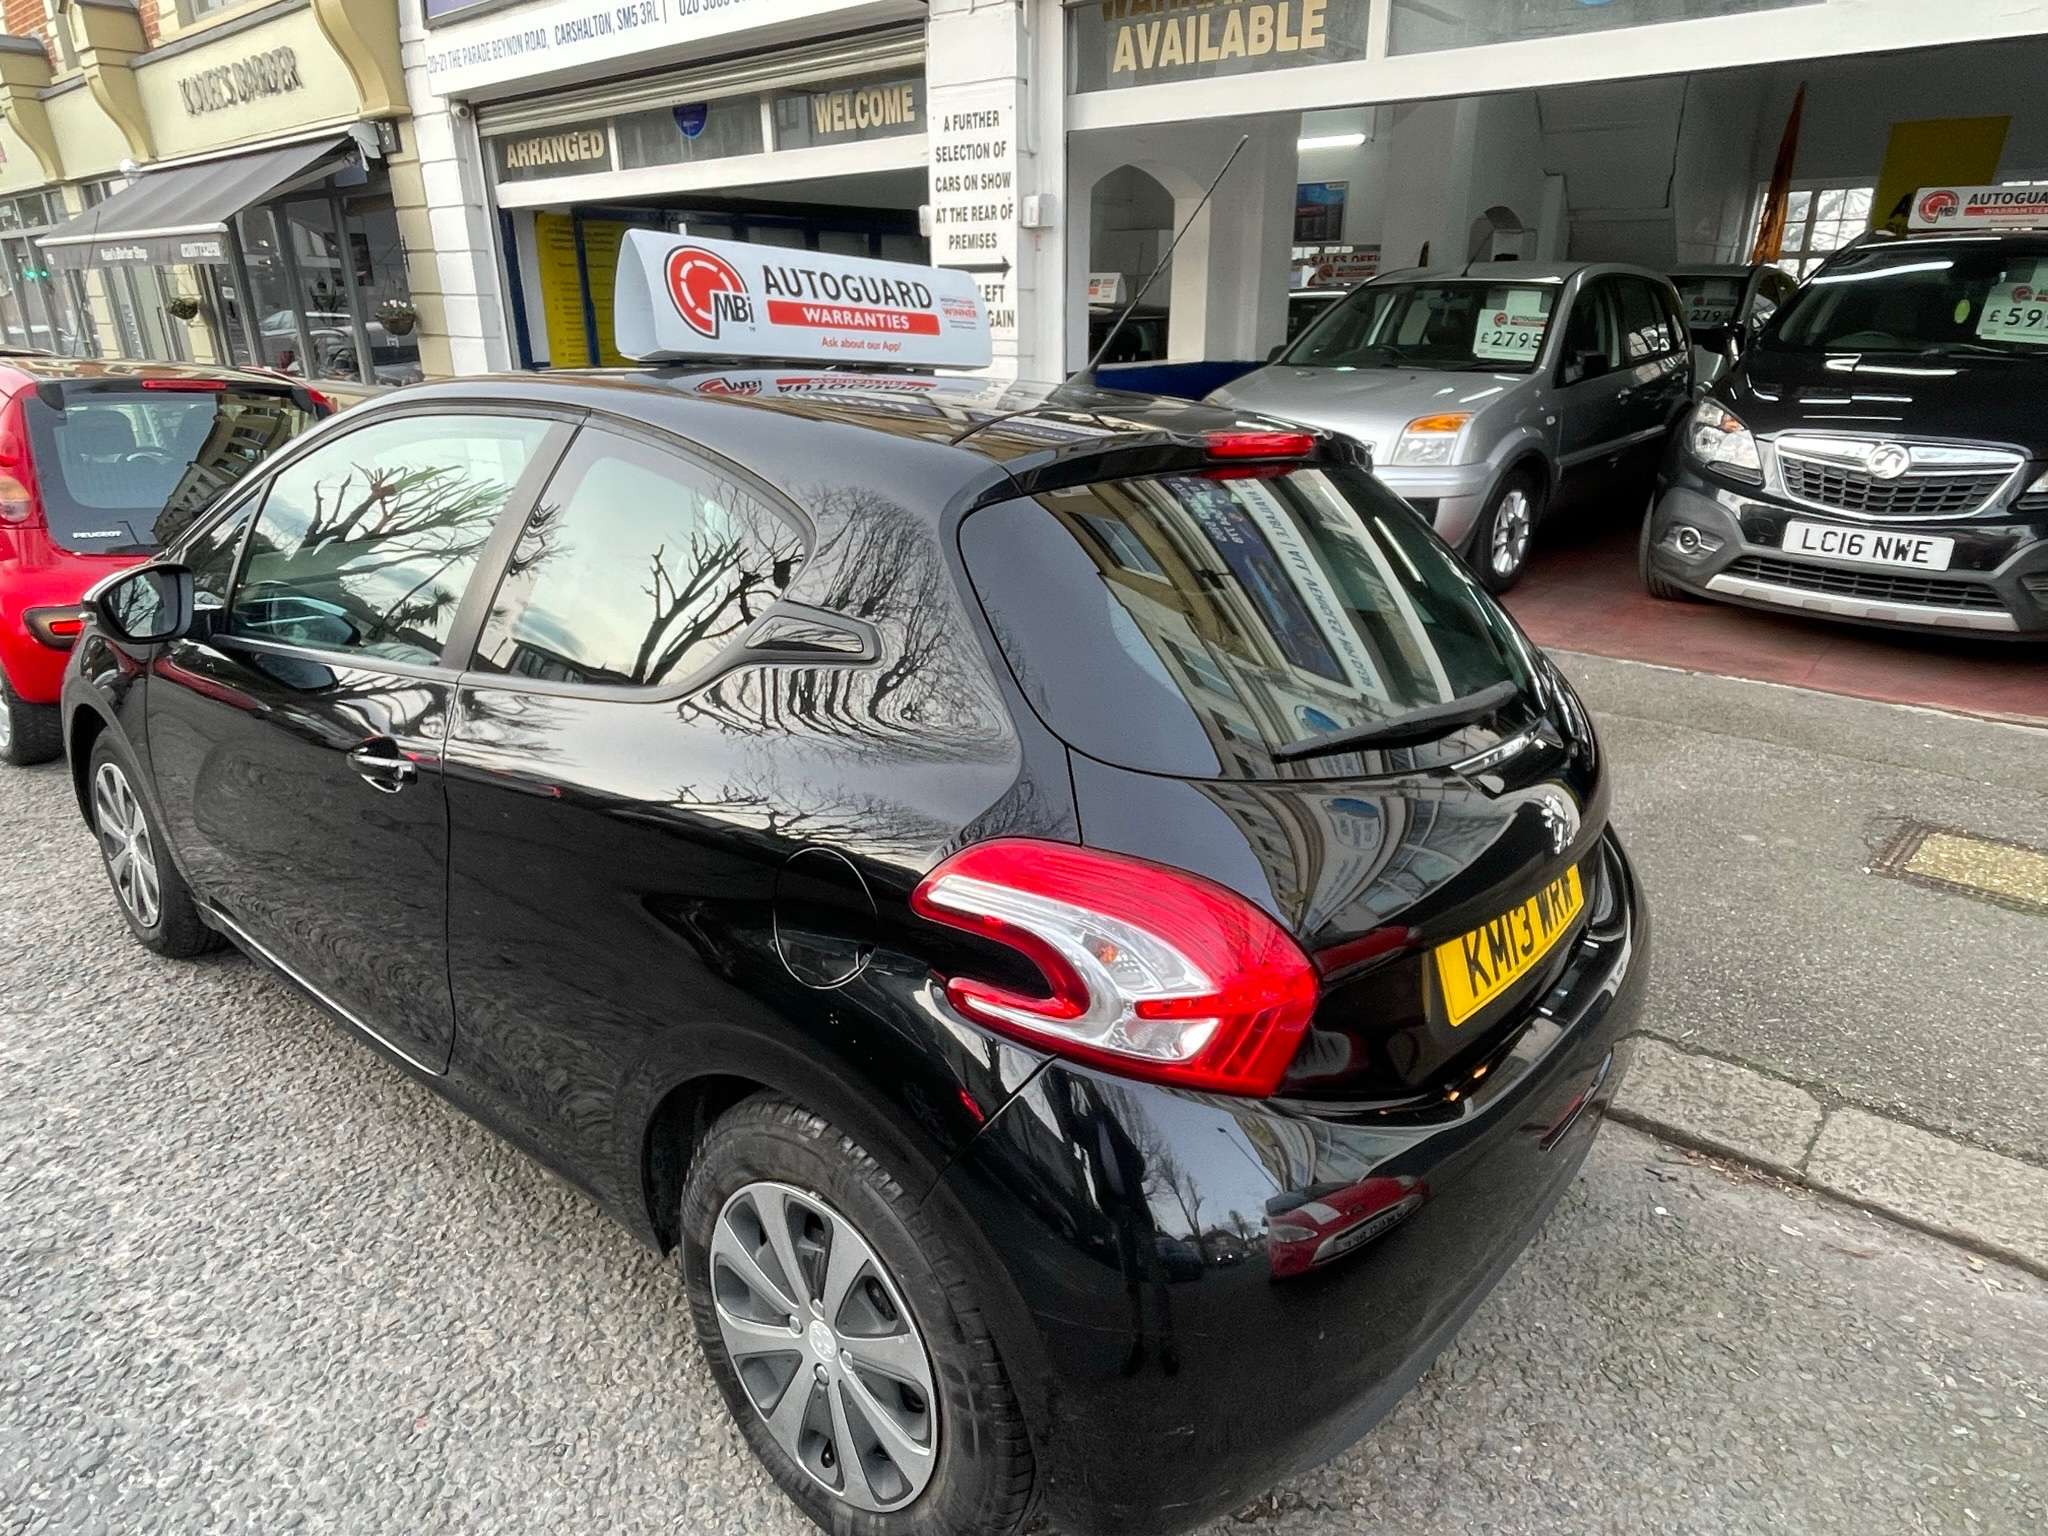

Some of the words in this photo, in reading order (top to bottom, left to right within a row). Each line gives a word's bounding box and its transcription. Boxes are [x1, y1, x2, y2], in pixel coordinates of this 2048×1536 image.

[448, 50, 463, 69] THE
[463, 42, 492, 66] PARADE
[493, 34, 523, 60] BEYNON
[554, 12, 615, 46] CARSHALTON,
[617, 5, 638, 31] SM5
[640, 0, 660, 25] 3RL
[1112, 0, 1327, 72] AVAILABLE
[815, 86, 915, 133] WELCOME
[944, 116, 950, 132] A
[953, 110, 1000, 131] FURTHER
[507, 129, 604, 168] ARRANGED
[935, 143, 990, 163] SELECTION
[994, 141, 1006, 158] OF
[936, 175, 961, 192] CARS
[964, 174, 978, 191] ON
[981, 171, 1011, 190] SHOW
[936, 208, 947, 224] AT
[950, 206, 968, 223] THE
[971, 206, 997, 222] REAR
[1000, 203, 1013, 220] OF
[949, 232, 997, 250] PREMISES
[762, 264, 933, 309] AUTOGUARD
[802, 307, 910, 330] WARRANTIES
[987, 310, 1015, 328] GAIN
[1988, 307, 2048, 329] £59
[821, 336, 838, 348] Ask
[840, 337, 865, 349] about
[867, 342, 881, 350] our
[882, 341, 901, 352] App!
[1801, 528, 1865, 556] LC16
[1872, 536, 1933, 563] NWE
[1461, 903, 1534, 998] KM13
